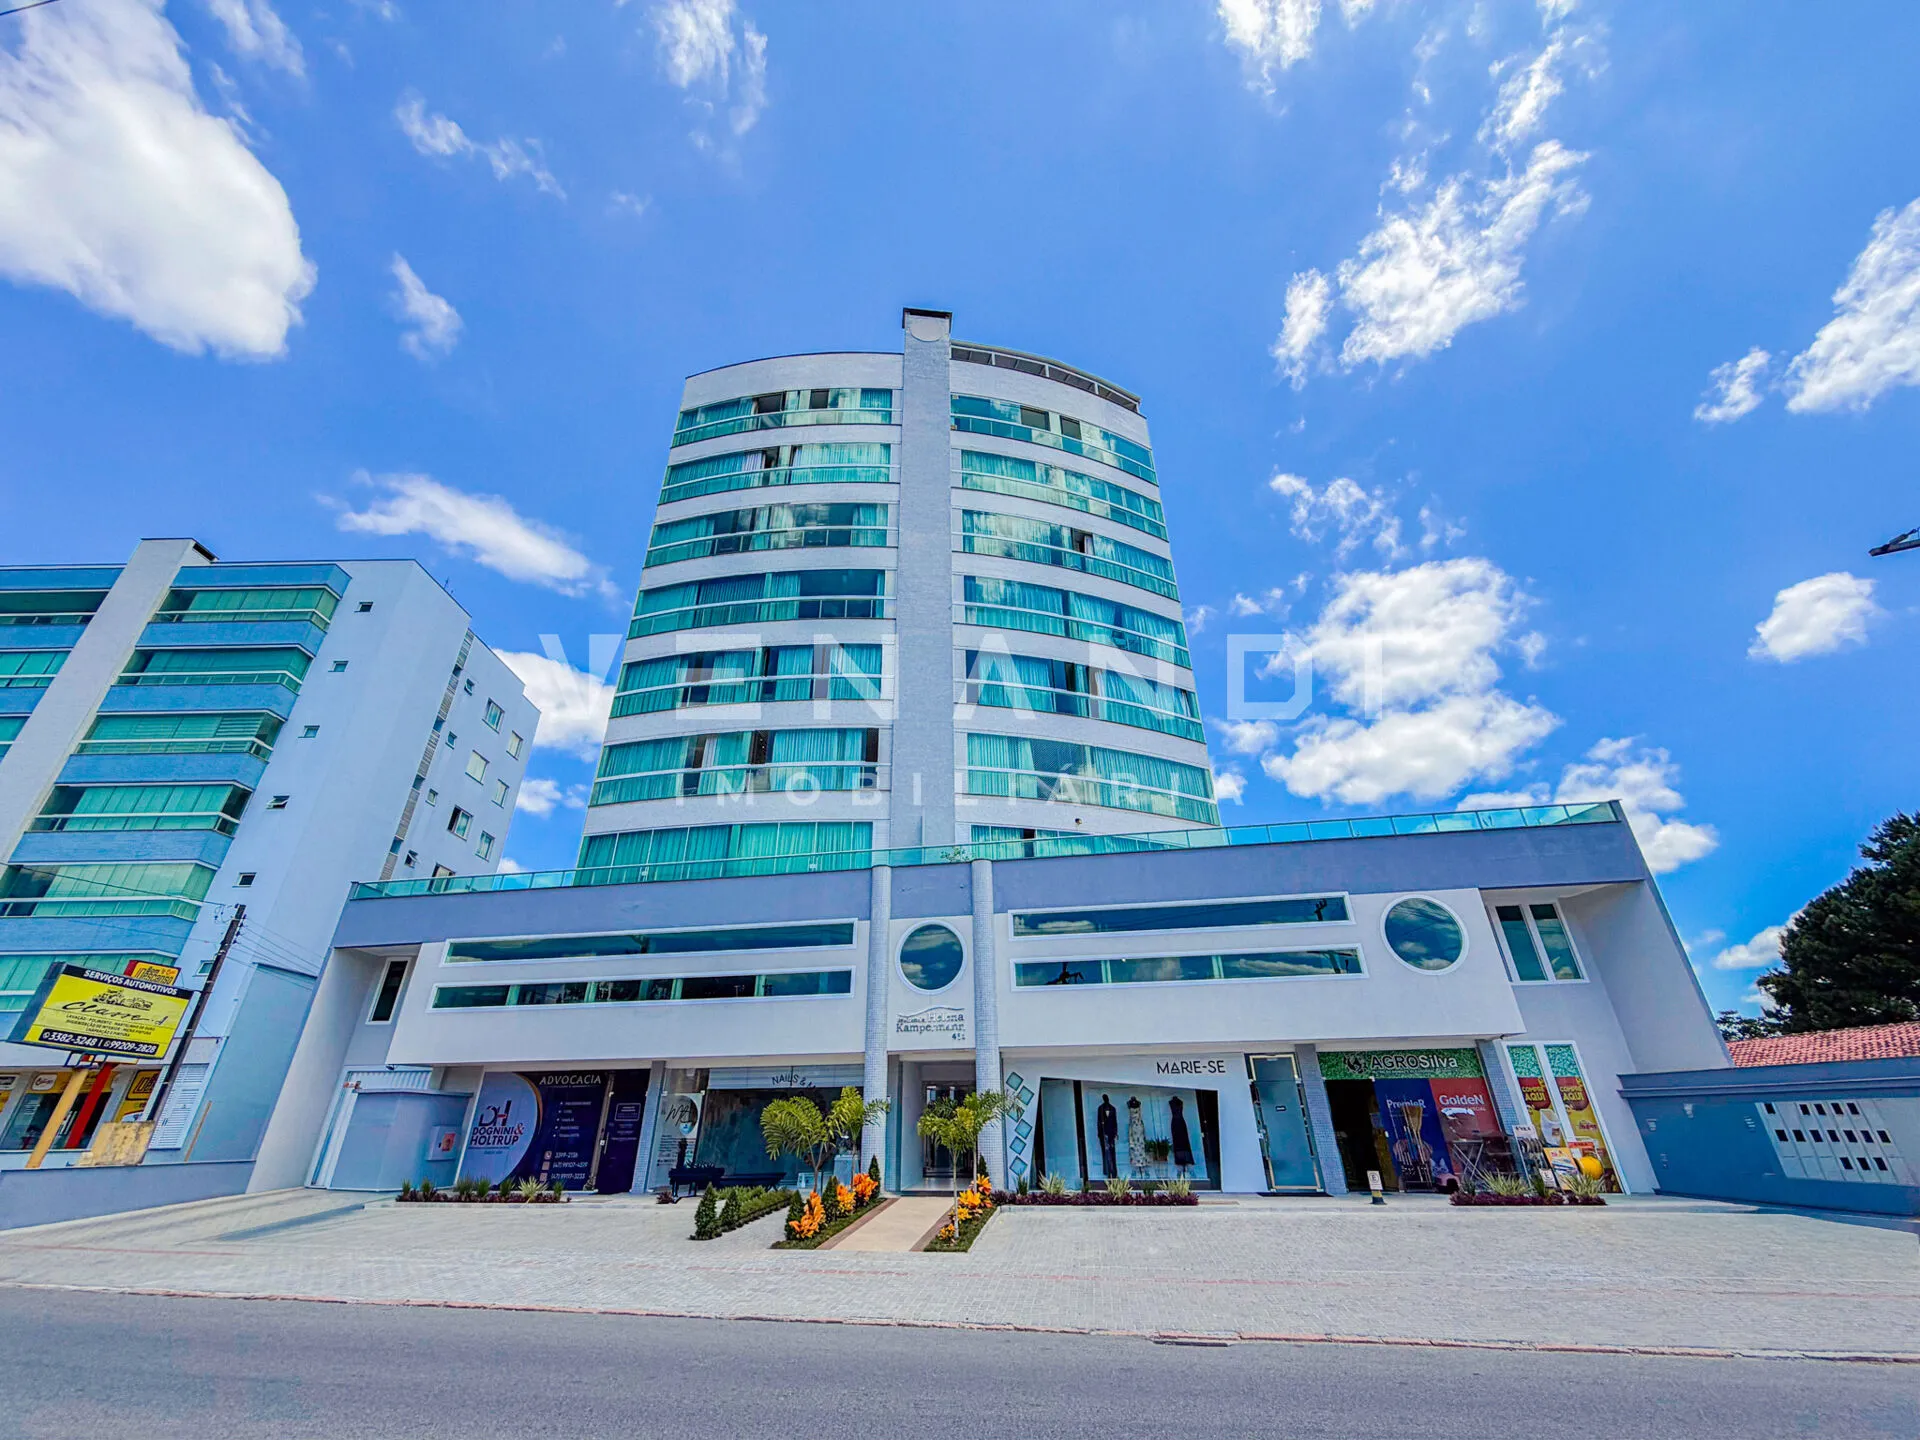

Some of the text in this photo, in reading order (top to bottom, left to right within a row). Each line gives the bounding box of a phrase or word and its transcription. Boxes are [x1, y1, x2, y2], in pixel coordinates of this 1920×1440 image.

[83, 969, 178, 995] SERVIÇOS AUTOMOTIVOS
[48, 1031, 157, 1054] 3382-3248 99209-2828
[1156, 1060, 1226, 1074] MARIE-SE
[1370, 1054, 1459, 1070] AGROSilva
[539, 1074, 602, 1085] ADVOCACIA
[772, 1074, 799, 1085] NAILS
[1438, 1094, 1485, 1106] GoldeN
[1525, 1092, 1546, 1101] AQUI
[1563, 1092, 1584, 1101] AQUI
[472, 1126, 514, 1135] DOGNINI
[469, 1135, 520, 1146] HOLTRUP
